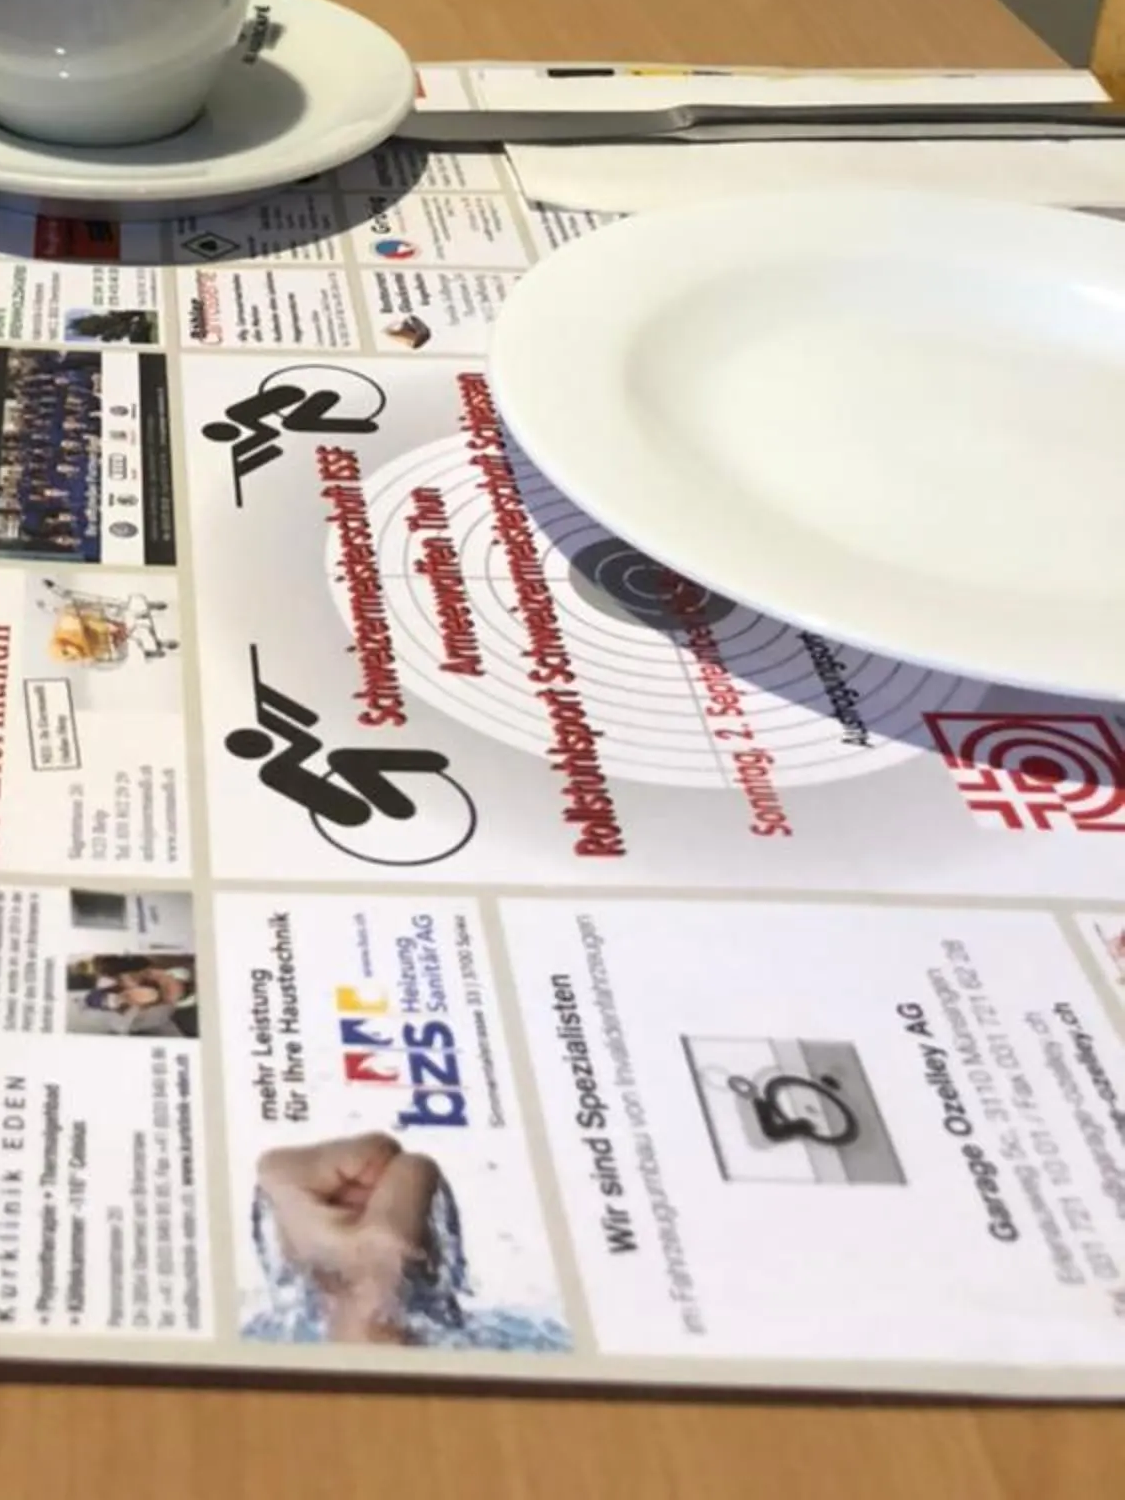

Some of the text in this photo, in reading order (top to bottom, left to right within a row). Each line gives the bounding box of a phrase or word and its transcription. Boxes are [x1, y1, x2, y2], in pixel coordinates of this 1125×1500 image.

[456, 372, 504, 452] Schiessen
[321, 485, 407, 727] Schweizermeisterschaft
[404, 487, 486, 677] Armeewaffen Thun
[469, 453, 575, 684] Schweizermeisterschaft
[535, 687, 627, 858] Rollstuhlsport
[731, 746, 793, 838] Sonntag,
[250, 968, 278, 1121] mehr Leistung
[267, 912, 309, 1123] für Ihre Haustechnik
[396, 936, 421, 1013] Heizung
[412, 914, 448, 1014] Sanitär AG
[2, 1076, 25, 1150] EDEN
[397, 1020, 469, 1127] bzs
[549, 973, 637, 1255] Wir sind Spezialisten
[621, 1092, 648, 1129] von
[896, 1002, 1020, 1243] Garage Ozelley AG
[635, 1132, 696, 1302] Fahrzeugumbau
